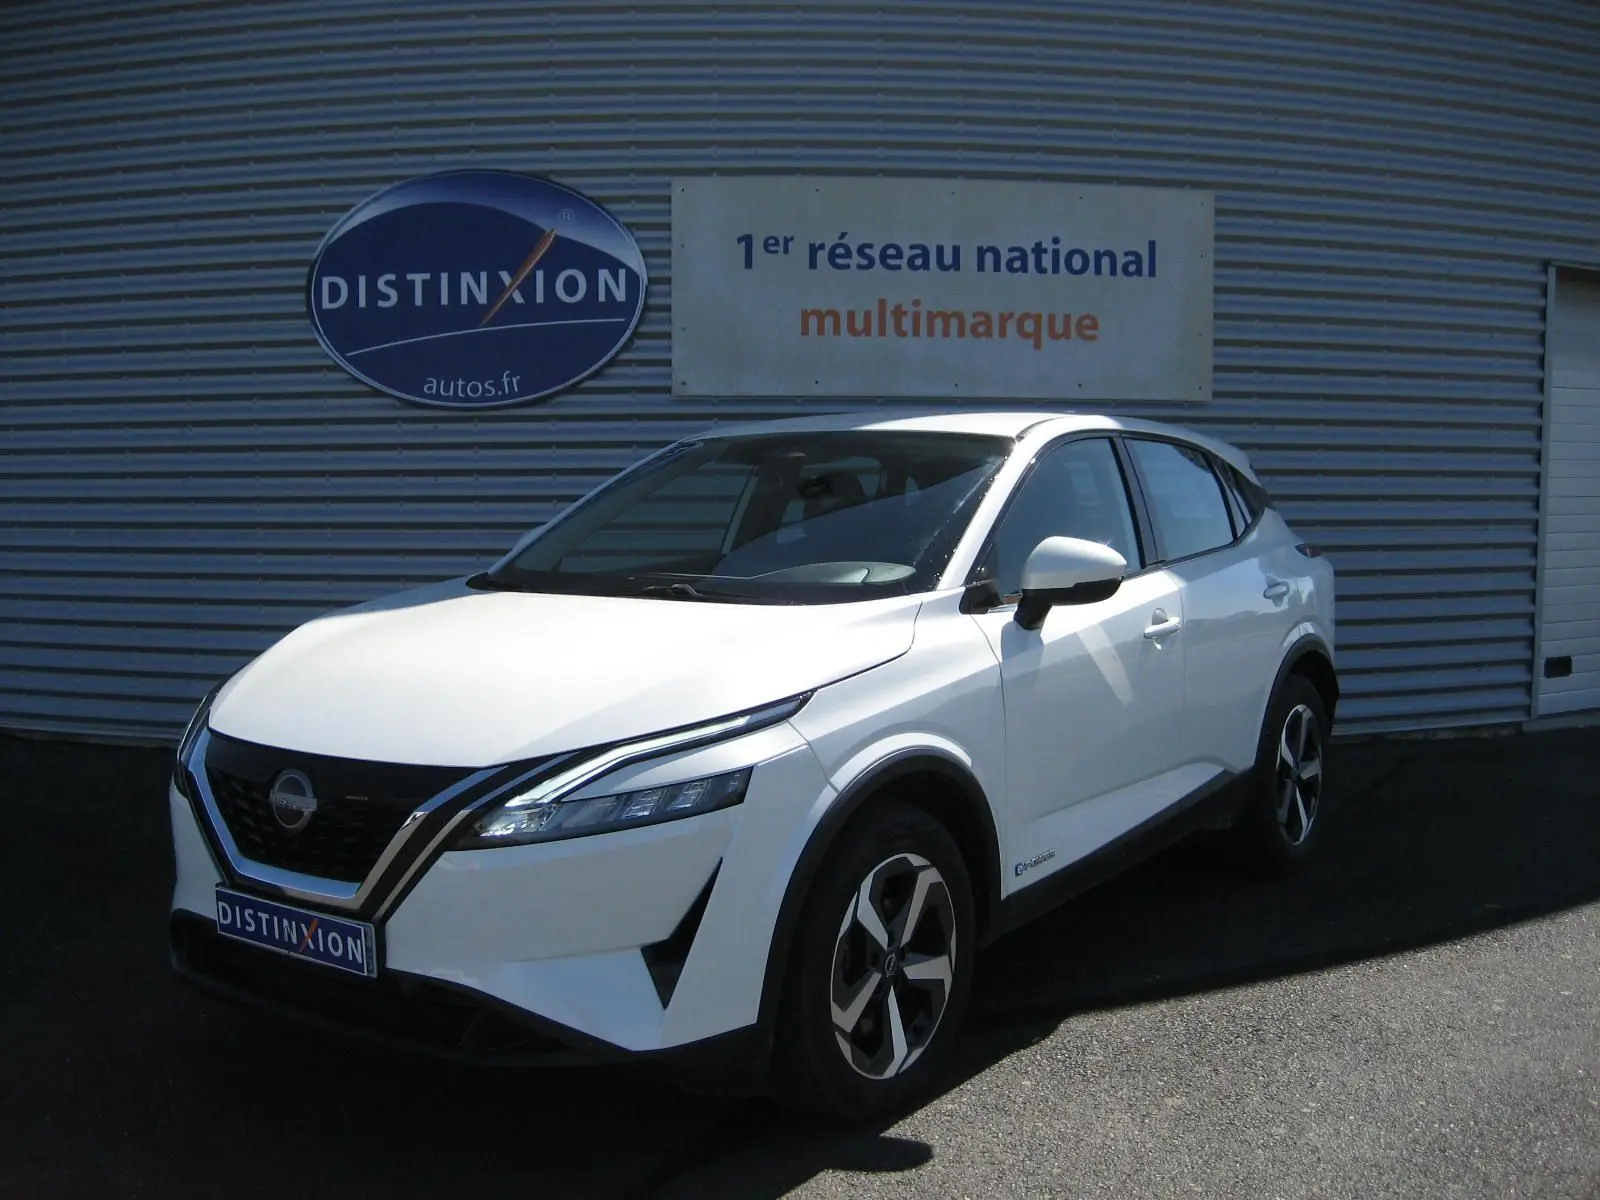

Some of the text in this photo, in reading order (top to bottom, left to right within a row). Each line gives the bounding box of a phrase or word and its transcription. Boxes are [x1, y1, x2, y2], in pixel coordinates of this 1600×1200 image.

[736, 231, 1157, 278] 1er réseau national
[321, 268, 626, 309] DISTINXION
[801, 299, 1100, 350] multimarque
[423, 371, 521, 398] autos.fr
[217, 901, 363, 964] DISTINXION
